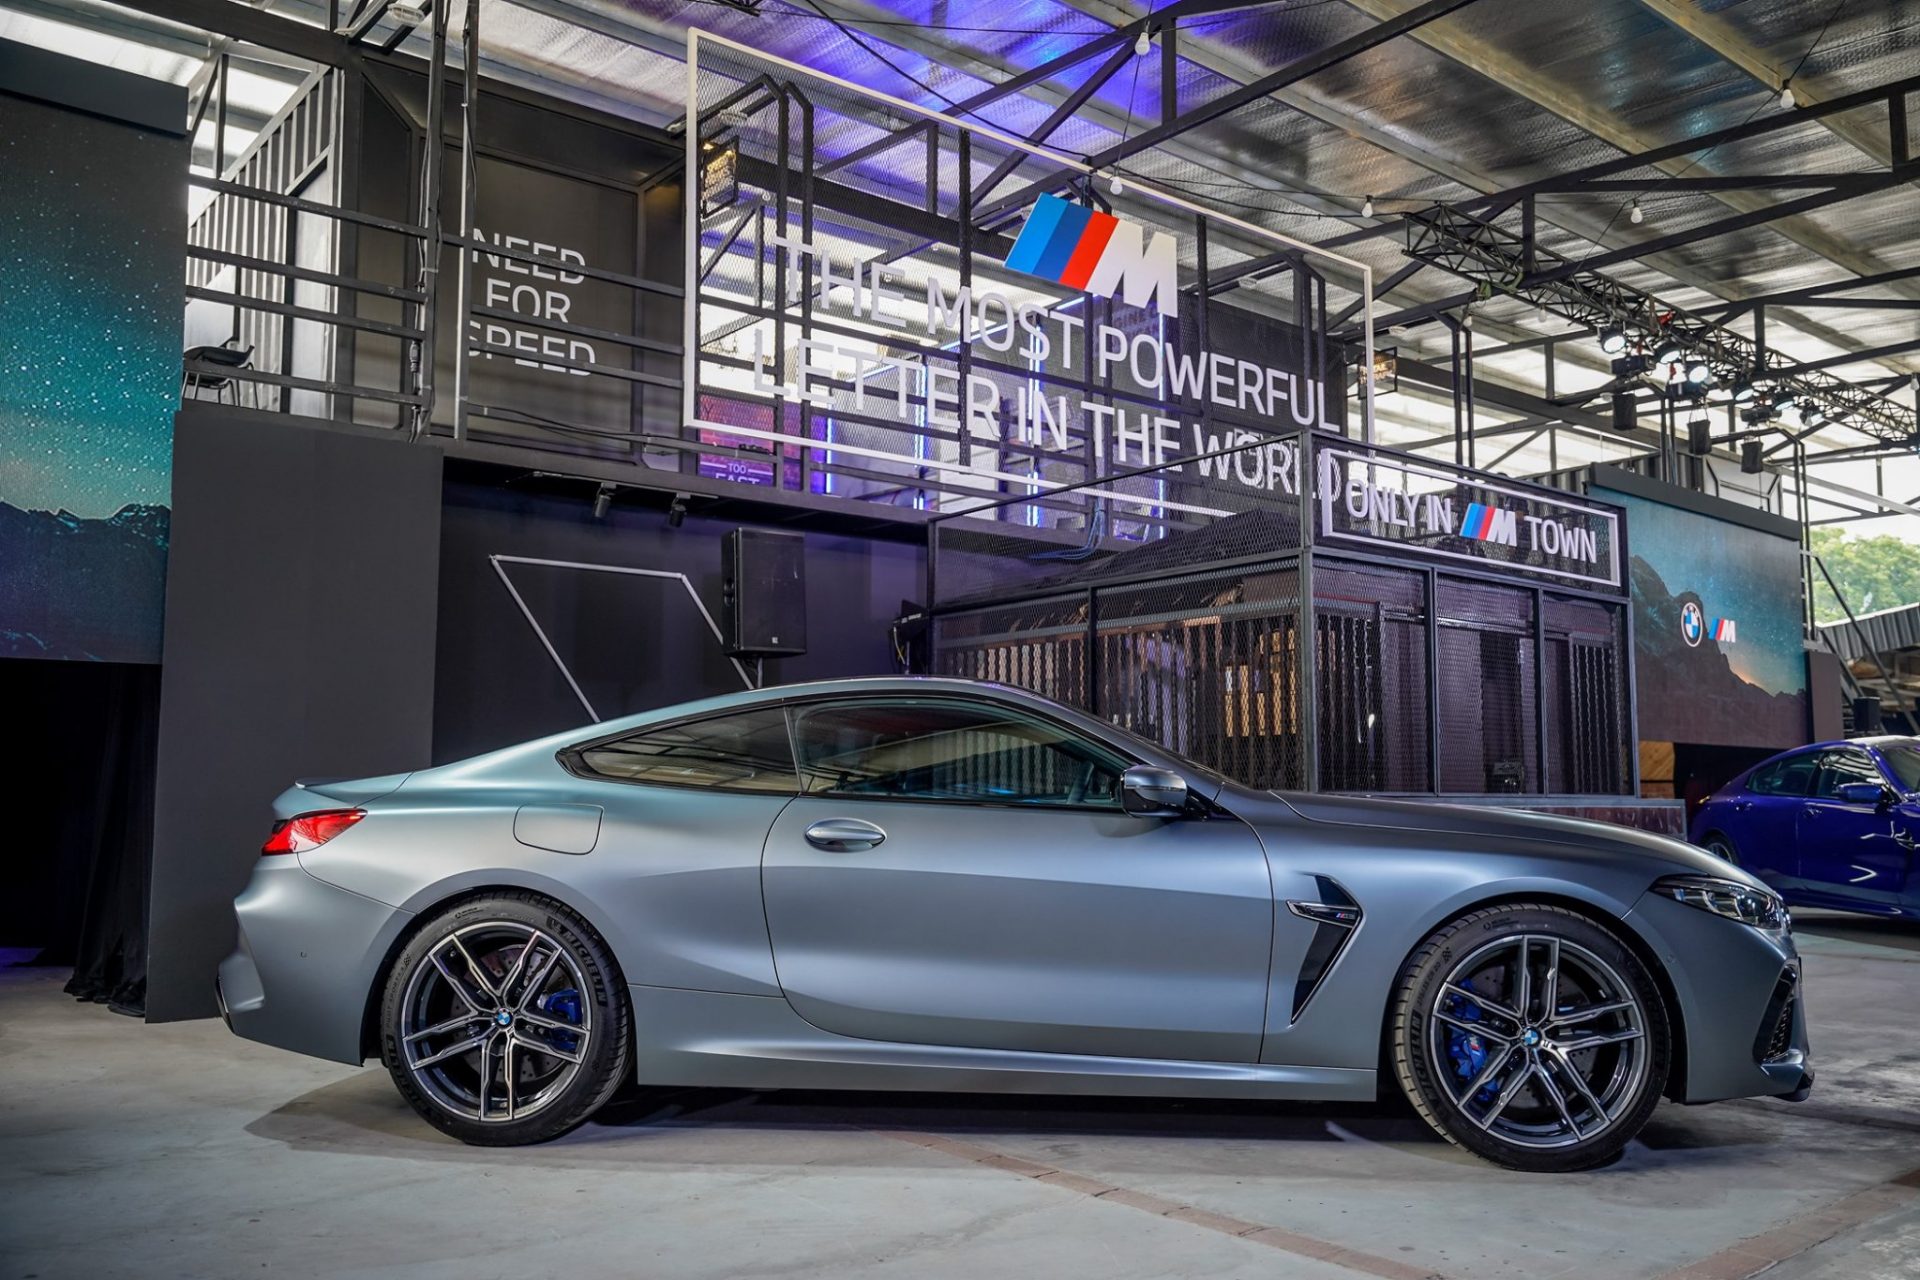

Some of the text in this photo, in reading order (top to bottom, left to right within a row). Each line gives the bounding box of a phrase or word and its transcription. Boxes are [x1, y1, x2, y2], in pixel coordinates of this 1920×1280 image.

[473, 228, 586, 284] NEED
[1087, 218, 1178, 318] M
[487, 278, 571, 323] FOR
[772, 236, 1340, 432] THE MOST POWERFUL
[754, 329, 1001, 437] LETTER
[1018, 387, 1067, 450] IN
[1081, 401, 1182, 472] THE
[728, 463, 746, 474] TOO
[1346, 479, 1597, 564] ONLY IN M TOWN
[562, 928, 608, 1003] MICHELIN
